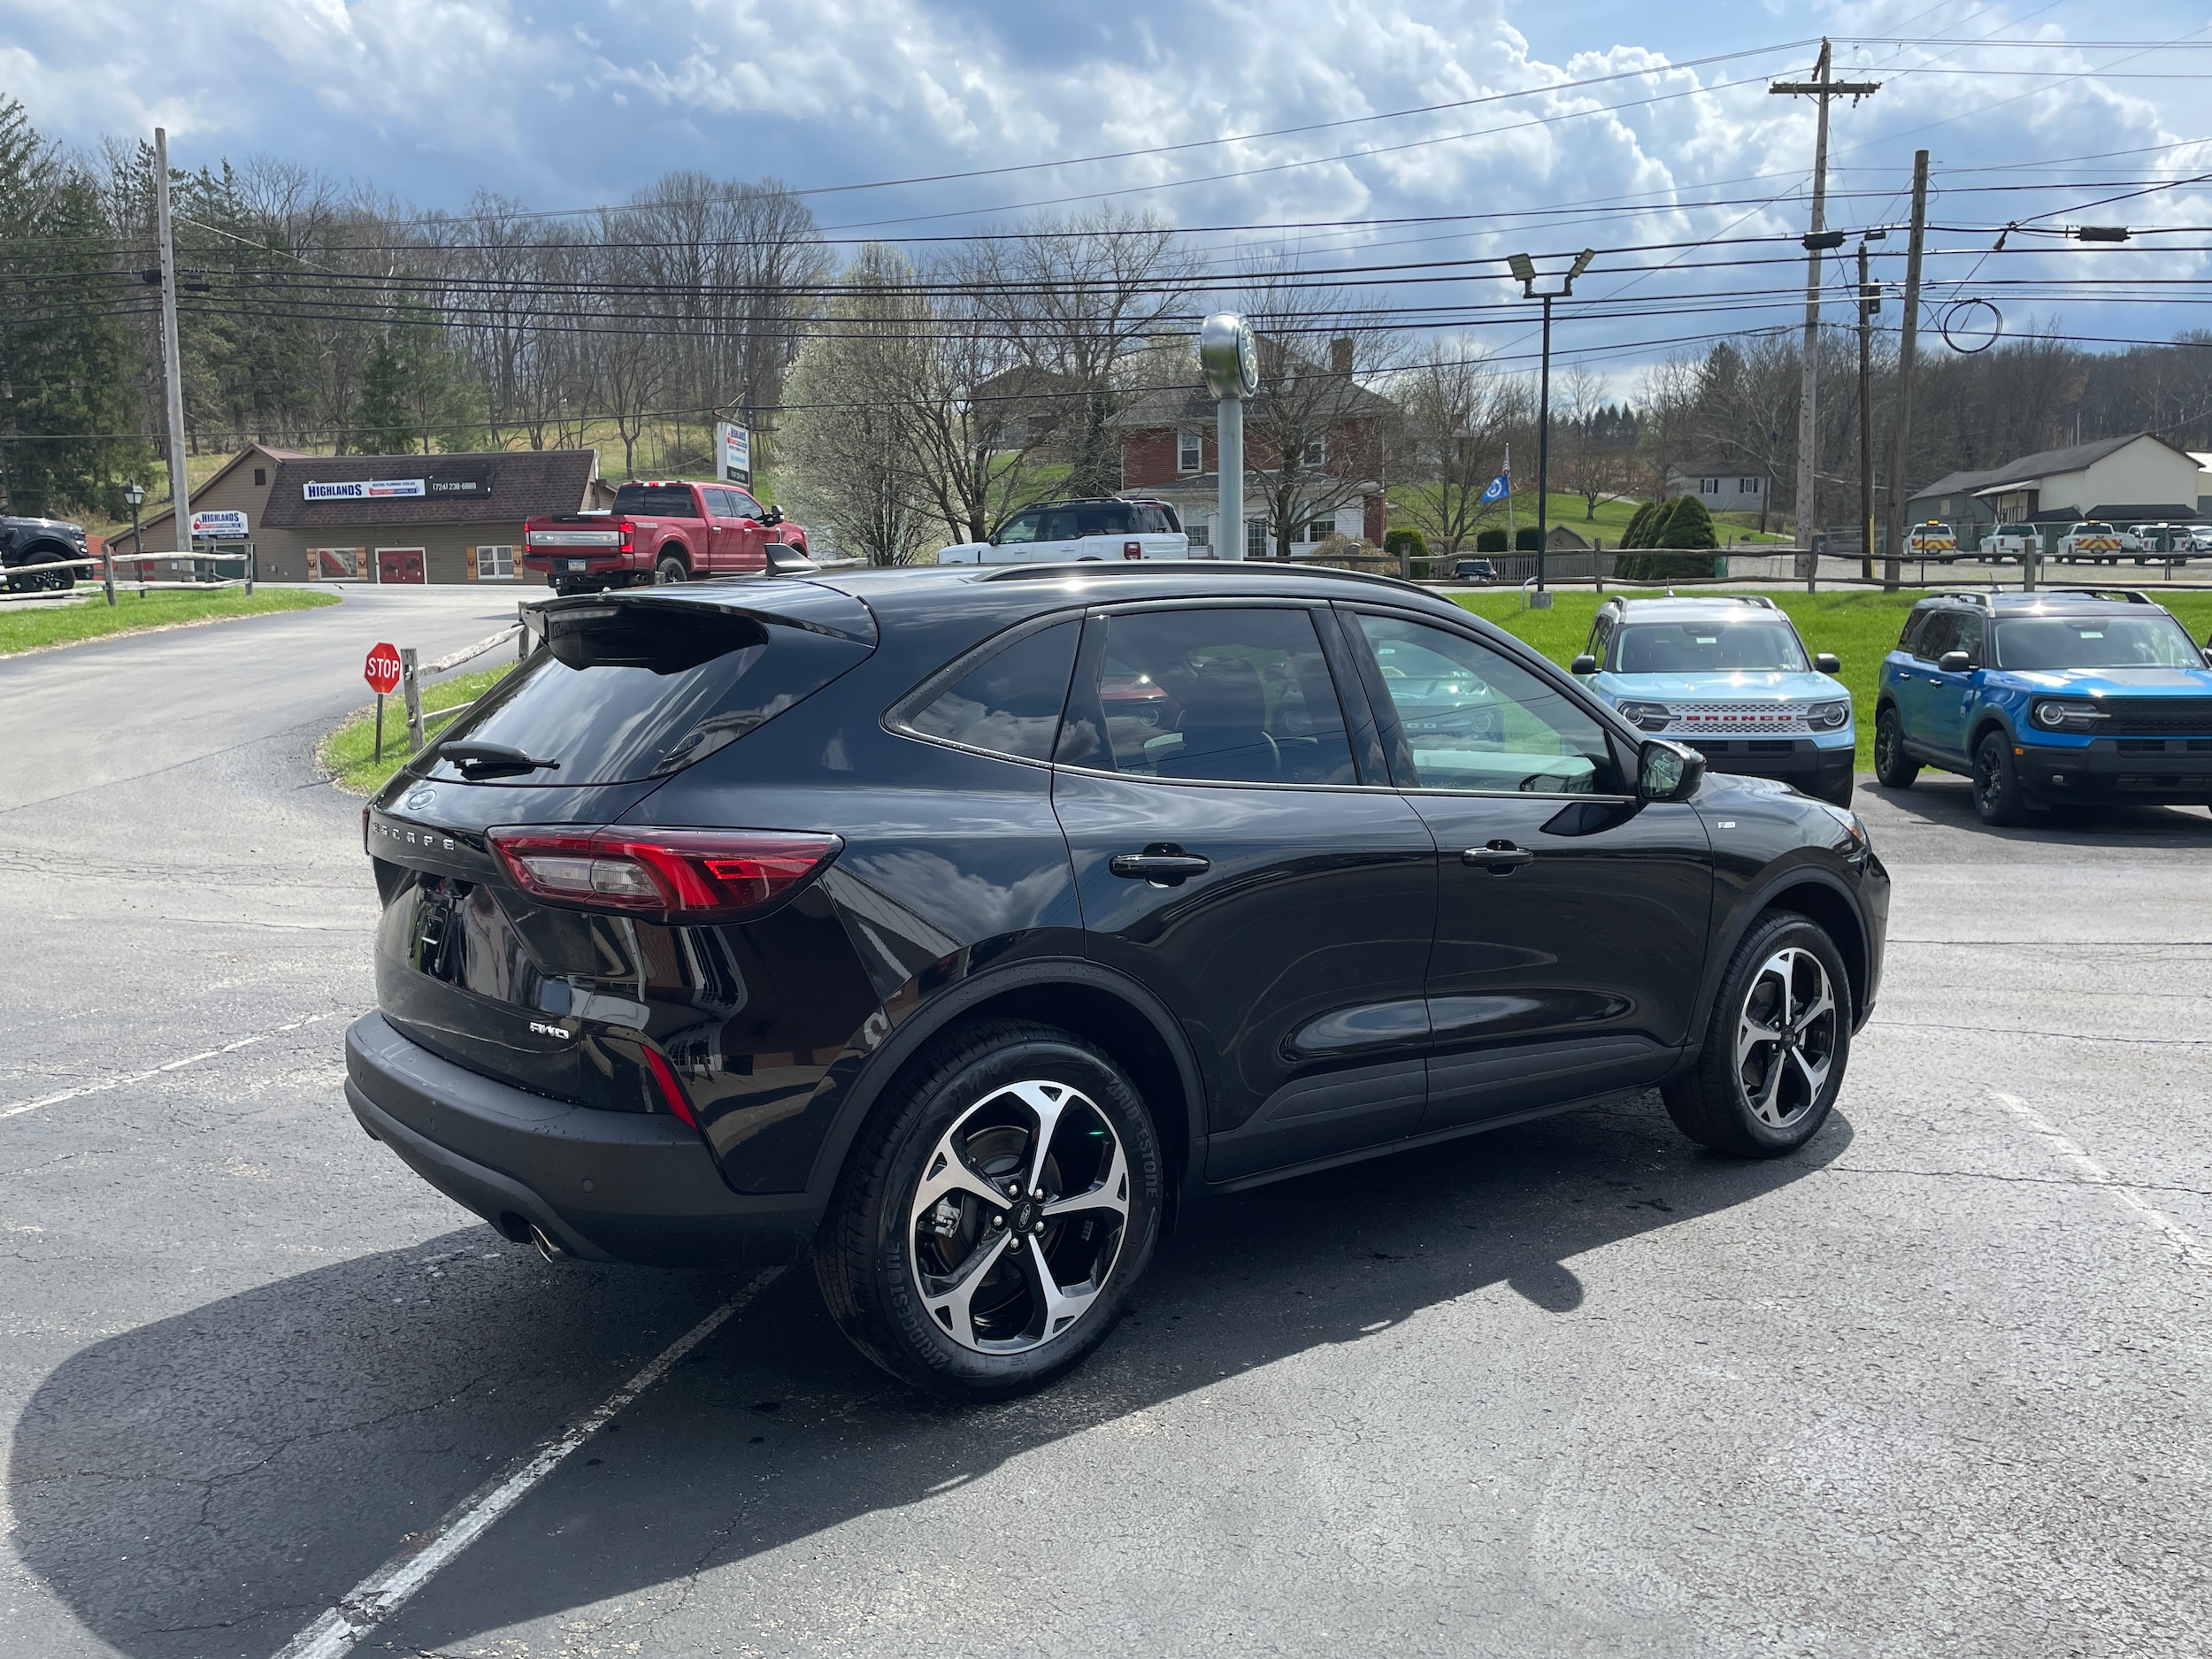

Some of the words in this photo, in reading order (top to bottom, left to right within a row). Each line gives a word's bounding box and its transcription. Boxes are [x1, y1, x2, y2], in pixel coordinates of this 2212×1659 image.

[308, 484, 362, 497] HIGHLANDS
[433, 482, 448, 491] (724)
[202, 512, 239, 522] HIGHLANDS
[367, 657, 400, 679] STOP
[373, 822, 455, 850] ESCAPE
[529, 1022, 570, 1040] AWD
[1106, 1078, 1158, 1198] BRIDGESTONE
[886, 1239, 951, 1370] BRIDGESTONE
